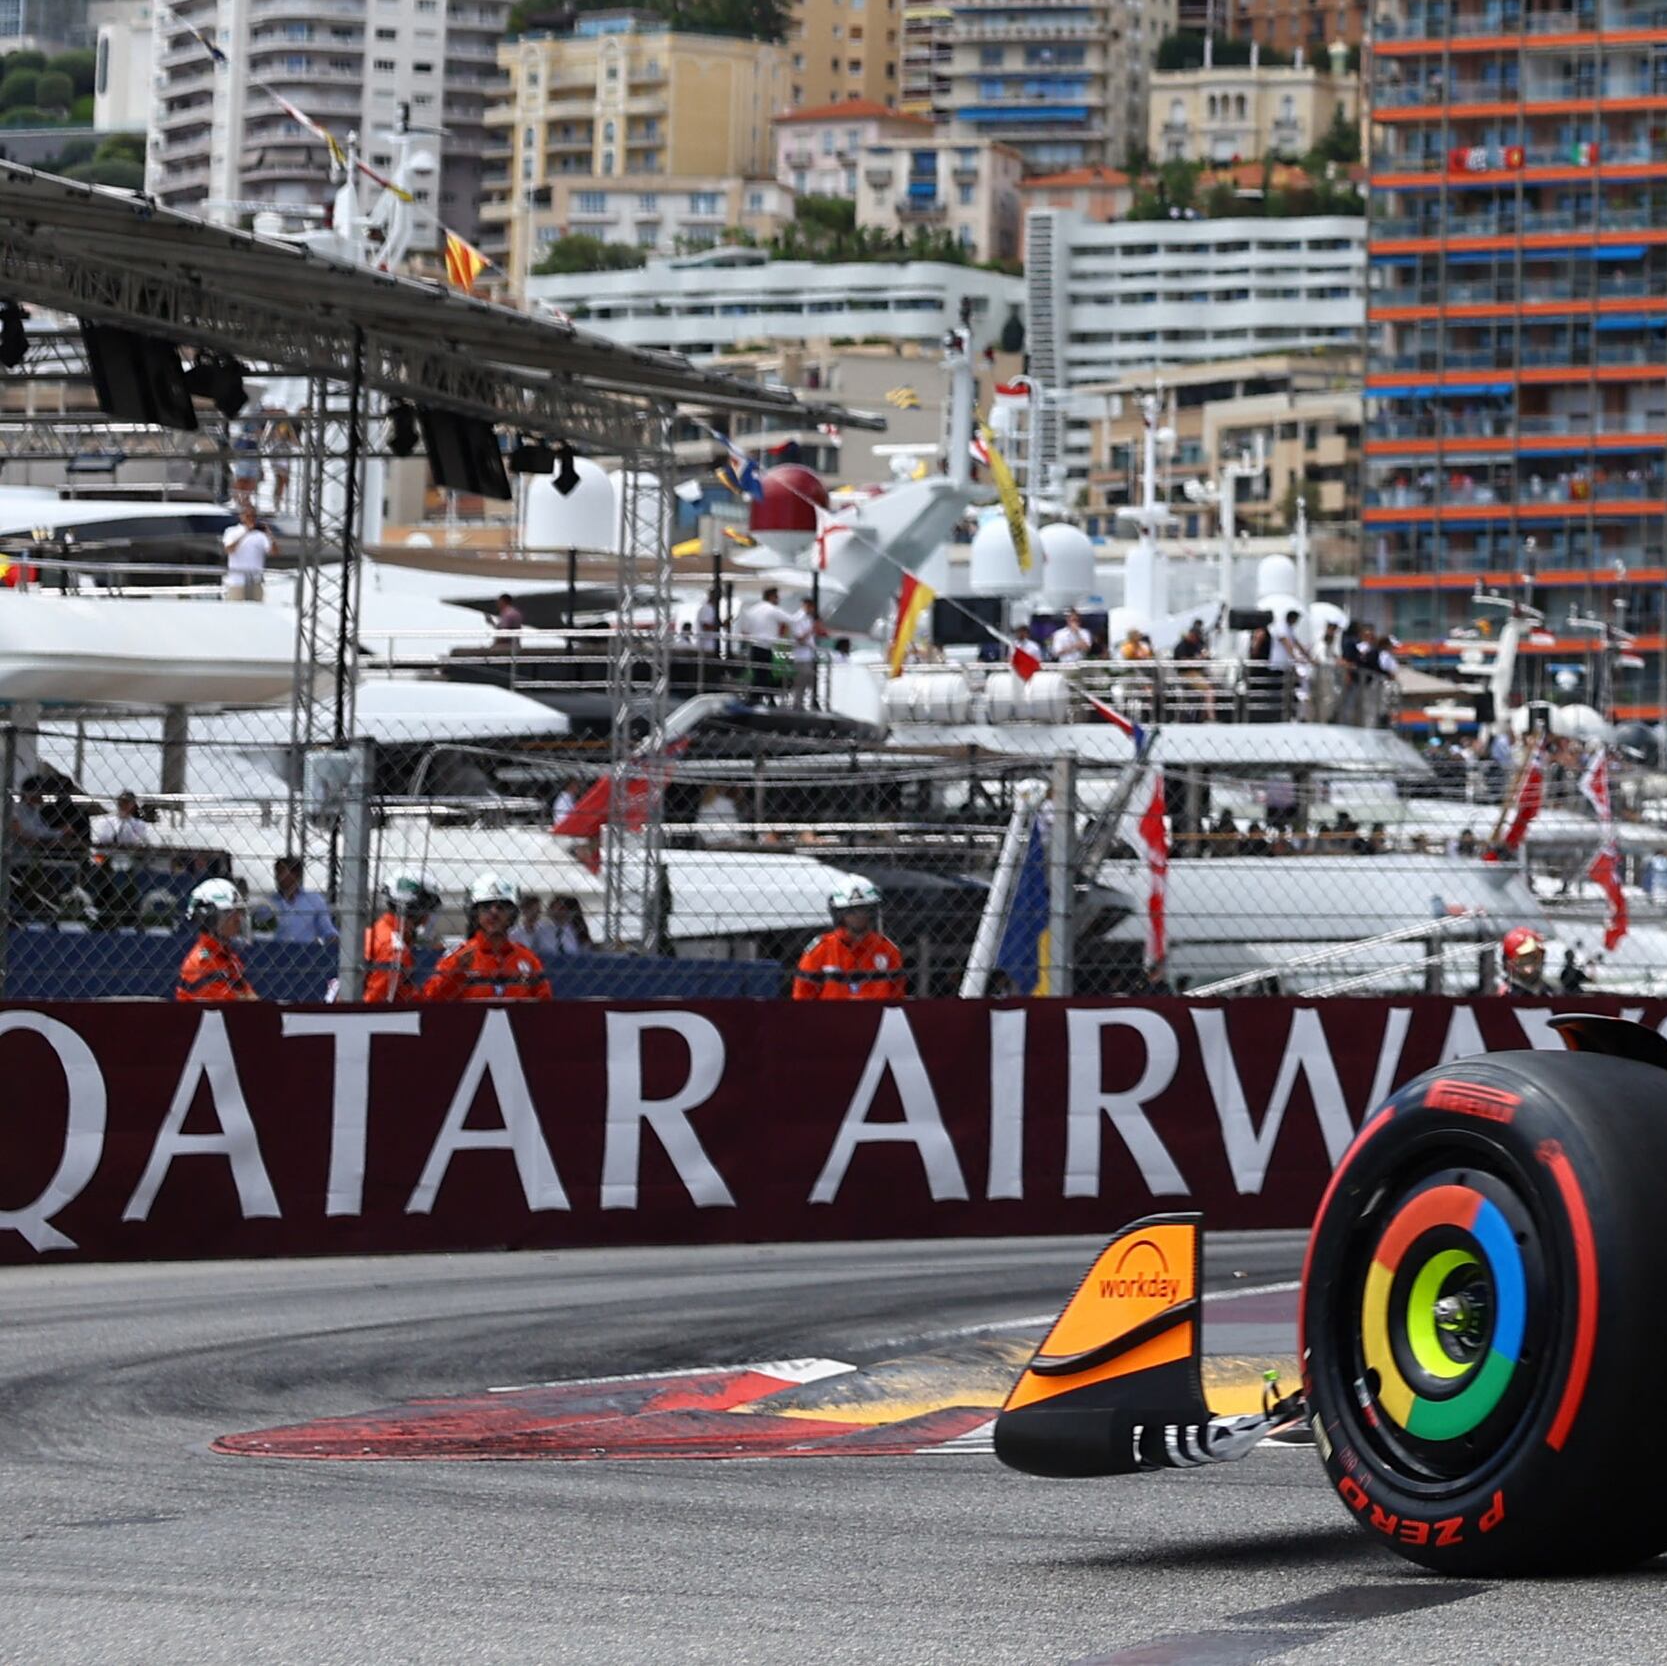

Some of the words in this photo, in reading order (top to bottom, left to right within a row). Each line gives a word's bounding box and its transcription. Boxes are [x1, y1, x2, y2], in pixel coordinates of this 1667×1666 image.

[0, 1008, 738, 1253] QATAR
[1099, 1271, 1181, 1304] workday
[1336, 1475, 1464, 1548] ZERO
[1478, 1489, 1506, 1533] P
